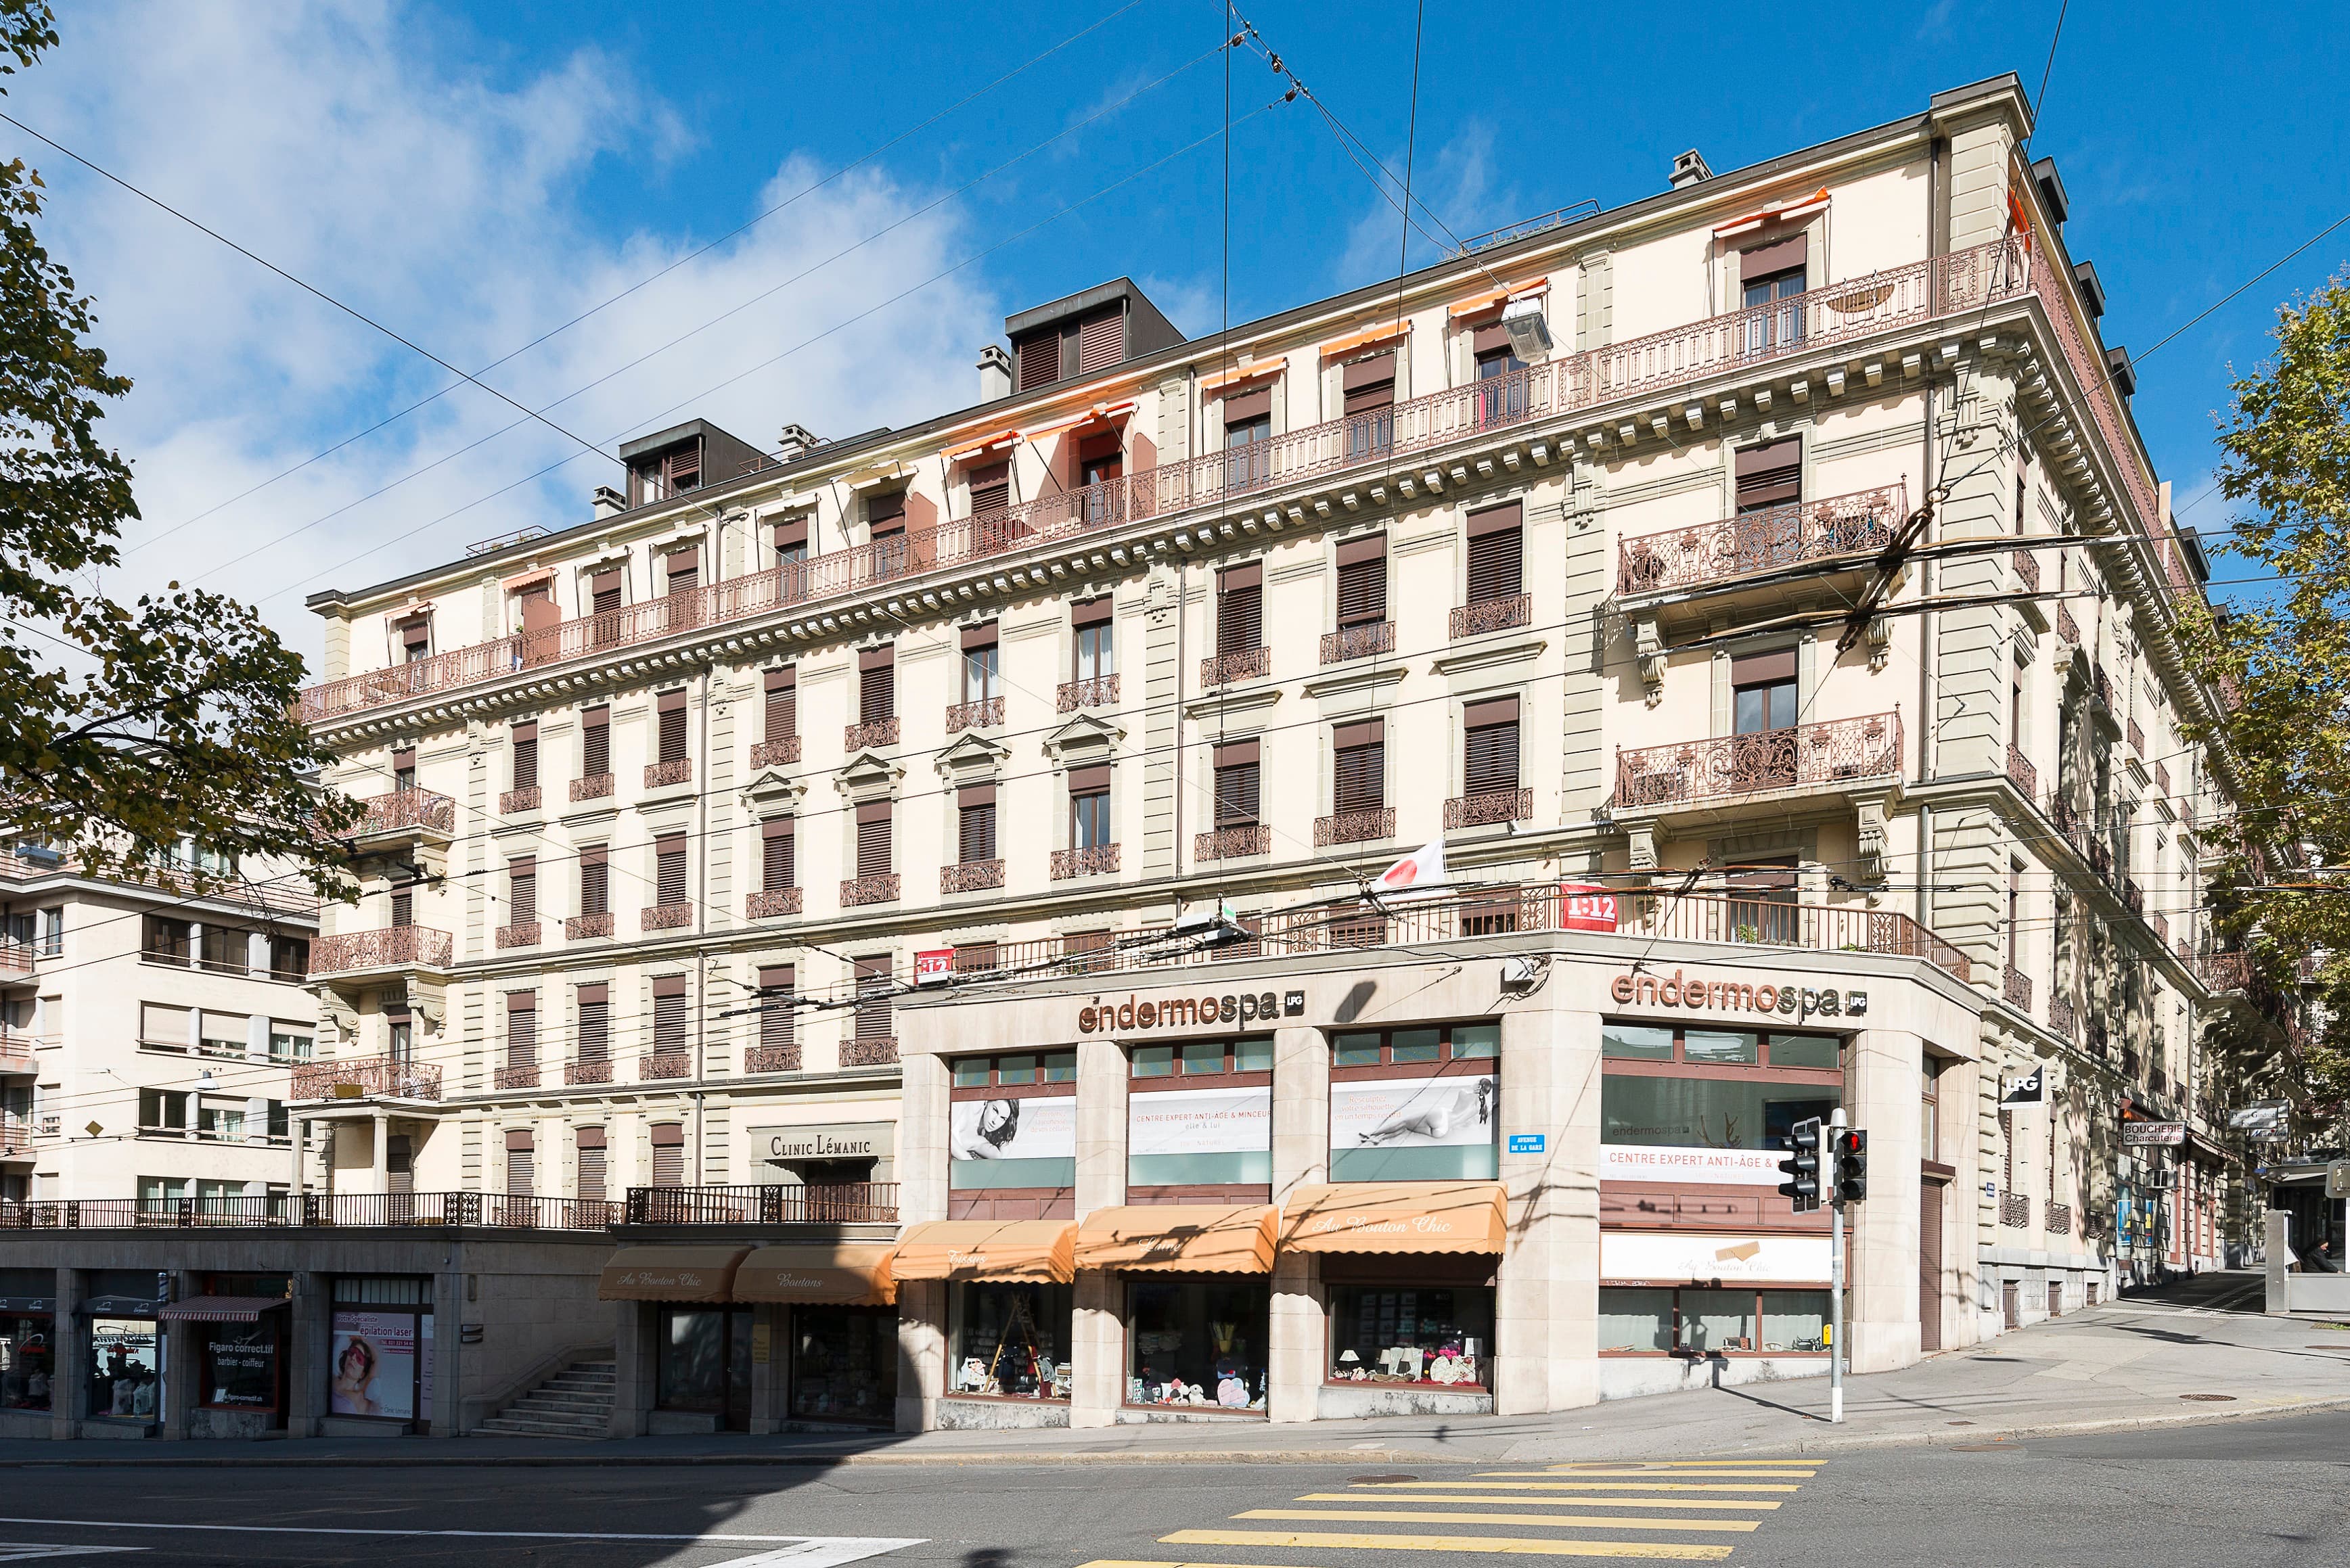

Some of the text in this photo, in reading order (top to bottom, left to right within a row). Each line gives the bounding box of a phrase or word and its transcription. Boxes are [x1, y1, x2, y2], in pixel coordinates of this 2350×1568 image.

[1568, 896, 1615, 919] 1:12
[1612, 969, 1867, 1023] endermospa LPG
[1079, 994, 1303, 1032] endermospa LPG
[2006, 1076, 2039, 1092] LPG
[1136, 1114, 1164, 1123] CENTRE
[1165, 1113, 1192, 1122] EXPERT
[1194, 1110, 1228, 1121] ANTI-ÂGE
[1613, 1126, 1681, 1137] endermospa
[2125, 1124, 2183, 1134] BOUCHERIE
[2125, 1134, 2182, 1143] Charcuterie
[1609, 1153, 1656, 1164] CENTRE
[1660, 1154, 1703, 1166] EXPERT
[1708, 1154, 1761, 1168] ANTI-ÂGE
[1765, 1158, 1772, 1168] &
[1312, 1216, 1452, 1233] Au Bouton Chic
[1138, 1236, 1181, 1252] Laine
[948, 1250, 985, 1264] Tissus
[617, 1272, 702, 1287] Au Bouton Chic
[777, 1272, 823, 1287] Boutons
[360, 1324, 392, 1337] épilation
[394, 1326, 412, 1337] laser
[208, 1342, 274, 1354] Figaro correct.tif
[217, 1357, 238, 1366] barbier
[242, 1358, 265, 1368] coiffeur
